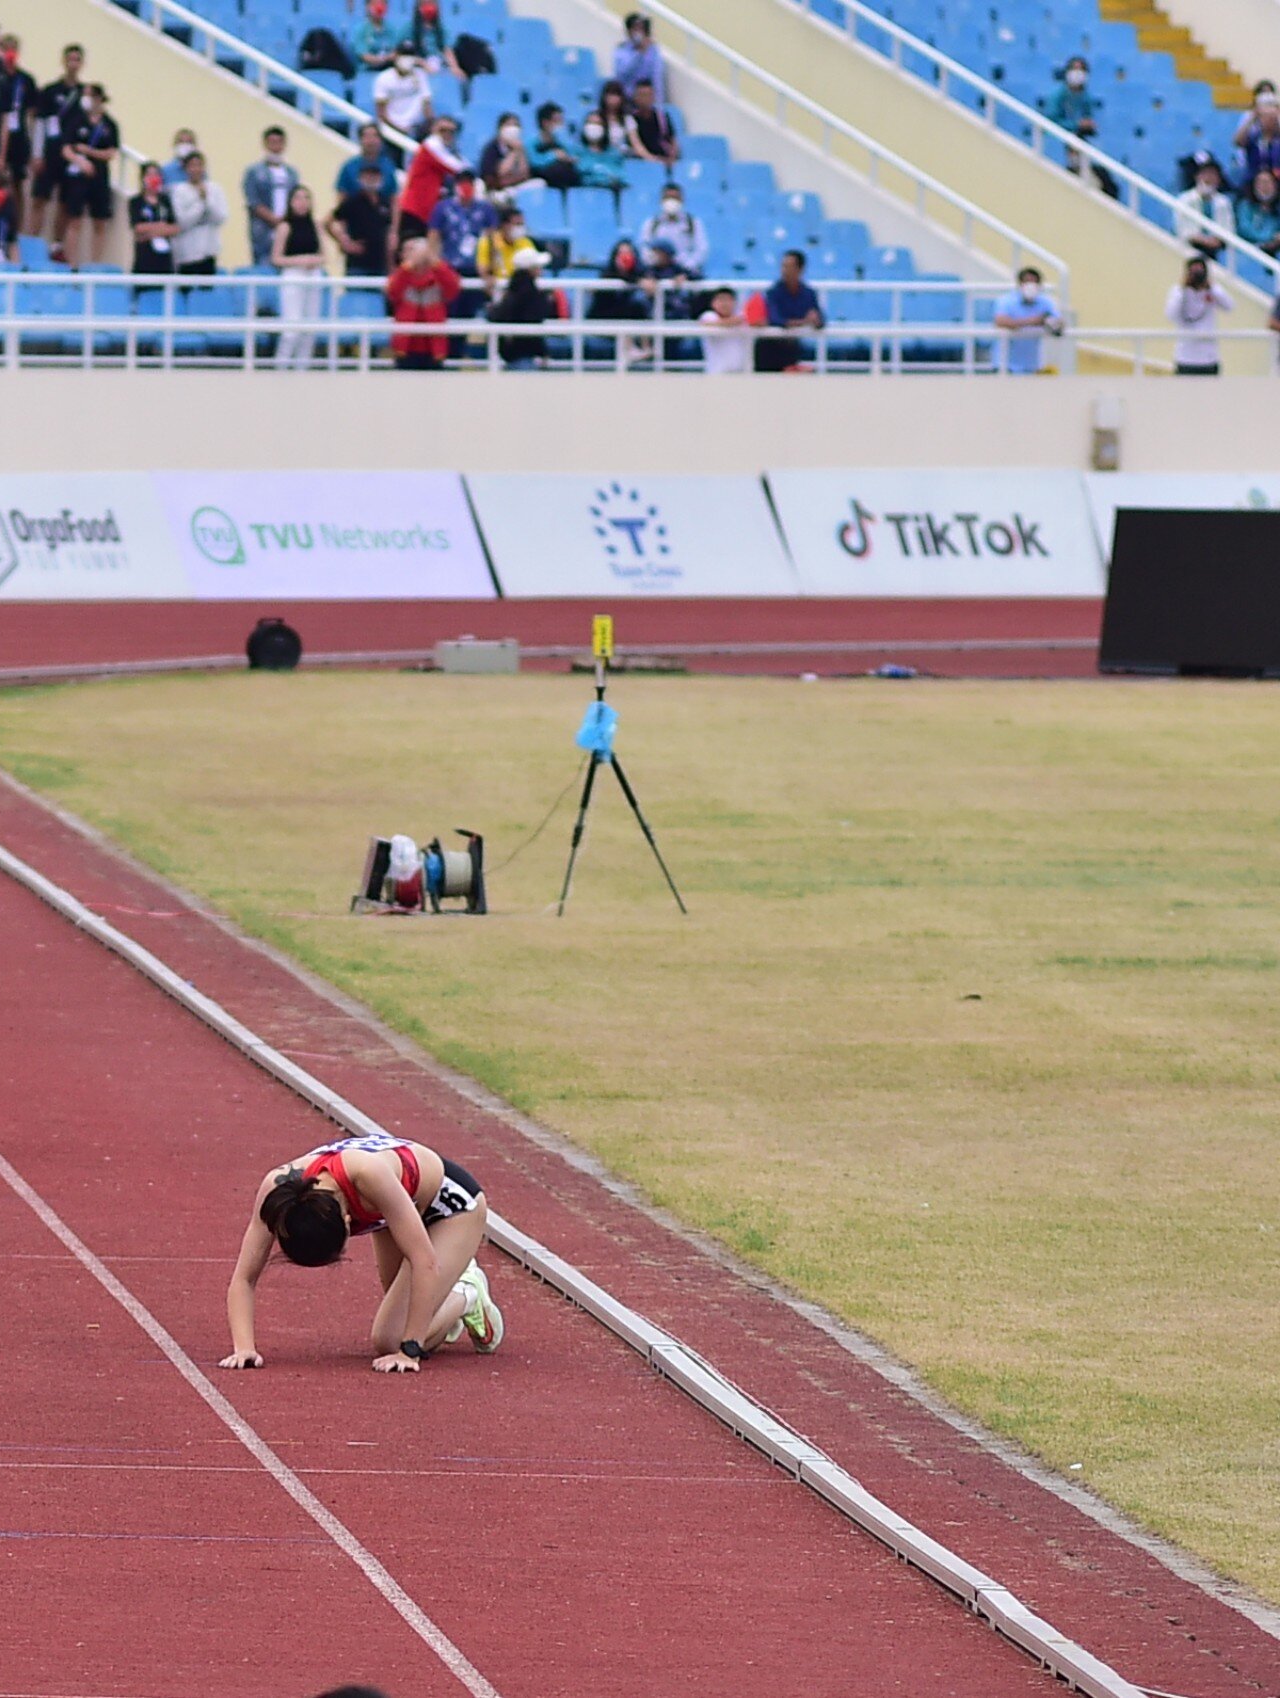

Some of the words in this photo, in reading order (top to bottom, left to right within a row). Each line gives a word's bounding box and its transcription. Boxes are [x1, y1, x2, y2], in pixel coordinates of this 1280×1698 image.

[9, 508, 121, 551] OrgaFood
[249, 523, 315, 550] TVU
[319, 523, 450, 550] Networks
[884, 512, 1049, 557] TikTok
